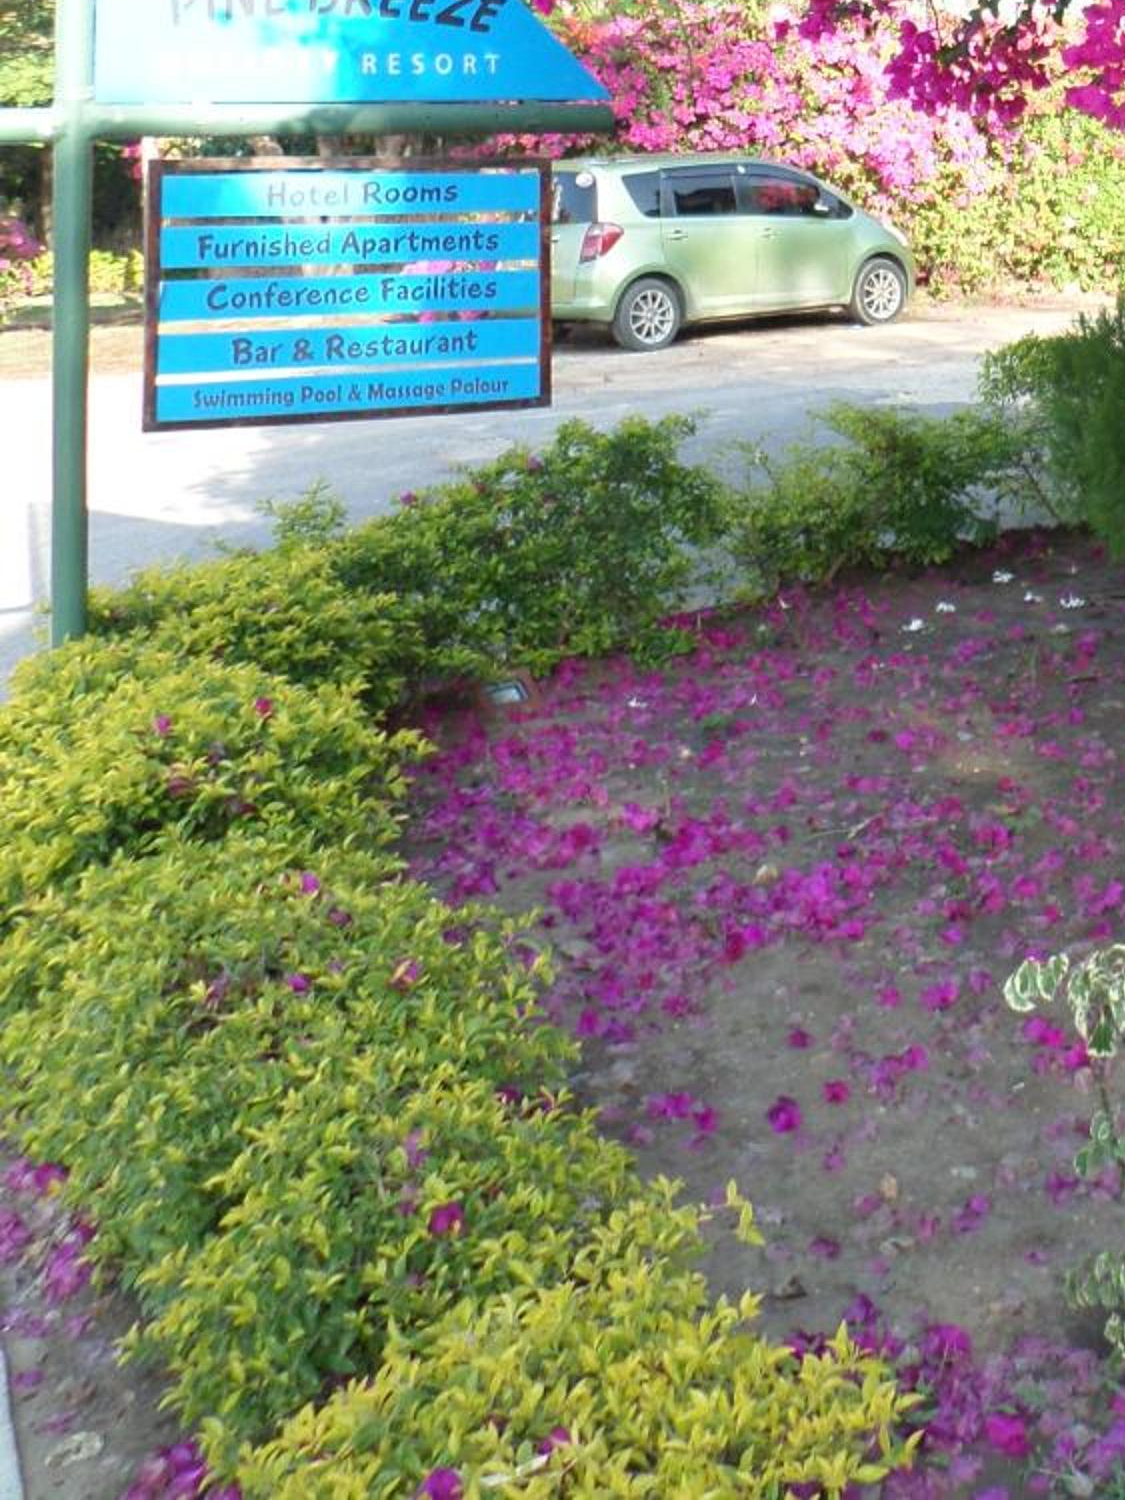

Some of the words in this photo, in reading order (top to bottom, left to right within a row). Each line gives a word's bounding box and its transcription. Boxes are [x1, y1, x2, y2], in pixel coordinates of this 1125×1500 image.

[362, 53, 499, 75] RESORT
[267, 181, 348, 208] Hotel
[363, 180, 458, 204] Rooms
[198, 231, 331, 260] Furnished
[340, 229, 499, 259] Apartments
[207, 279, 369, 311] Conference
[381, 275, 497, 301] Facilities
[231, 338, 281, 364] Bar
[293, 339, 313, 361] &
[326, 330, 478, 360] Restaurant
[193, 386, 295, 409] Swimming
[301, 382, 341, 403] Pool
[348, 381, 361, 400] &
